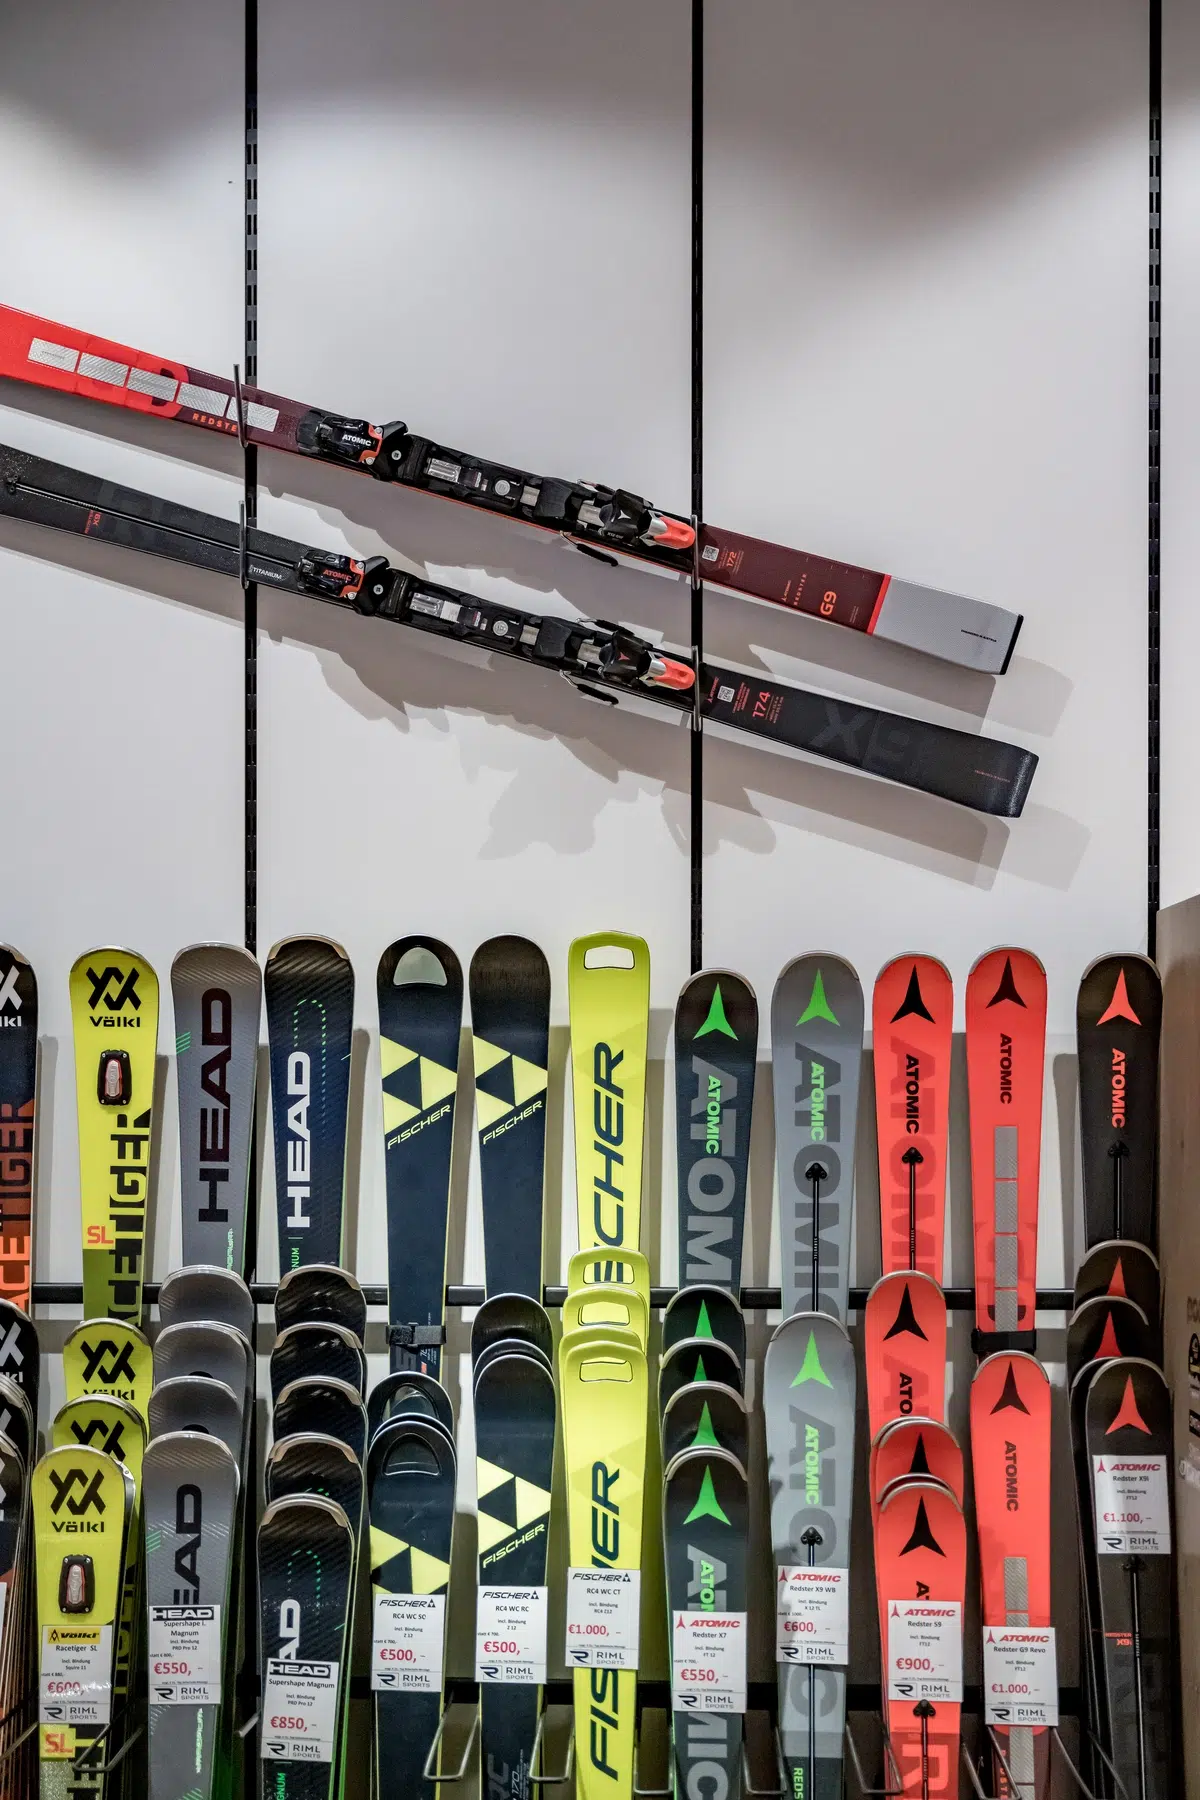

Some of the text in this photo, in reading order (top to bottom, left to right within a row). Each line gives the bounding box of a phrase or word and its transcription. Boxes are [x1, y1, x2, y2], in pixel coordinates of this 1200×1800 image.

[192, 412, 238, 432] REDSTE
[341, 434, 372, 447] ATOMIC
[726, 551, 737, 567] 172
[252, 567, 284, 580] TITANIUM
[322, 569, 352, 581] ATOMIC
[820, 590, 837, 616] G9
[752, 691, 771, 718] 174
[0, 1015, 22, 1028] lkl
[89, 1015, 141, 1028] Völkl
[999, 1032, 1013, 1105] ATOMIC
[905, 1054, 921, 1135] ATOMIC
[1111, 1048, 1126, 1129] ATOMIC
[199, 988, 232, 1222] HEAD
[810, 1060, 827, 1142] ATOMIC
[482, 1100, 543, 1145] FISCHER
[705, 1074, 724, 1155] ATOMIC
[387, 1104, 451, 1150] FISCHER
[287, 1051, 311, 1228] HEAD
[890, 1036, 936, 1278] ATOMI
[87, 1225, 114, 1244] SL
[804, 1423, 821, 1506] ATOMIC
[1004, 1440, 1019, 1512] ATOMIC
[51, 1521, 105, 1533] Völkl
[173, 1484, 202, 1604] AD
[482, 1523, 545, 1568] FISCHER
[572, 1573, 622, 1582] FISCHER
[792, 1574, 841, 1582] ATOMIC
[379, 1599, 427, 1608] FISCHER
[482, 1592, 530, 1600] FISCHER
[153, 1608, 213, 1620] HEAD
[904, 1608, 956, 1617] ATOMIC
[280, 1599, 301, 1659] AD
[690, 1619, 741, 1628] ATOMIC
[170, 1630, 199, 1638] Magnum
[806, 1648, 834, 1656] RIML
[270, 1662, 330, 1678] HEAD
[268, 1679, 306, 1687] Supershape
[921, 1685, 950, 1693] RIML
[705, 1696, 734, 1704] RIML
[45, 1733, 76, 1754] SL
[293, 1744, 320, 1753] RIML
[793, 1767, 804, 1800] REDS
